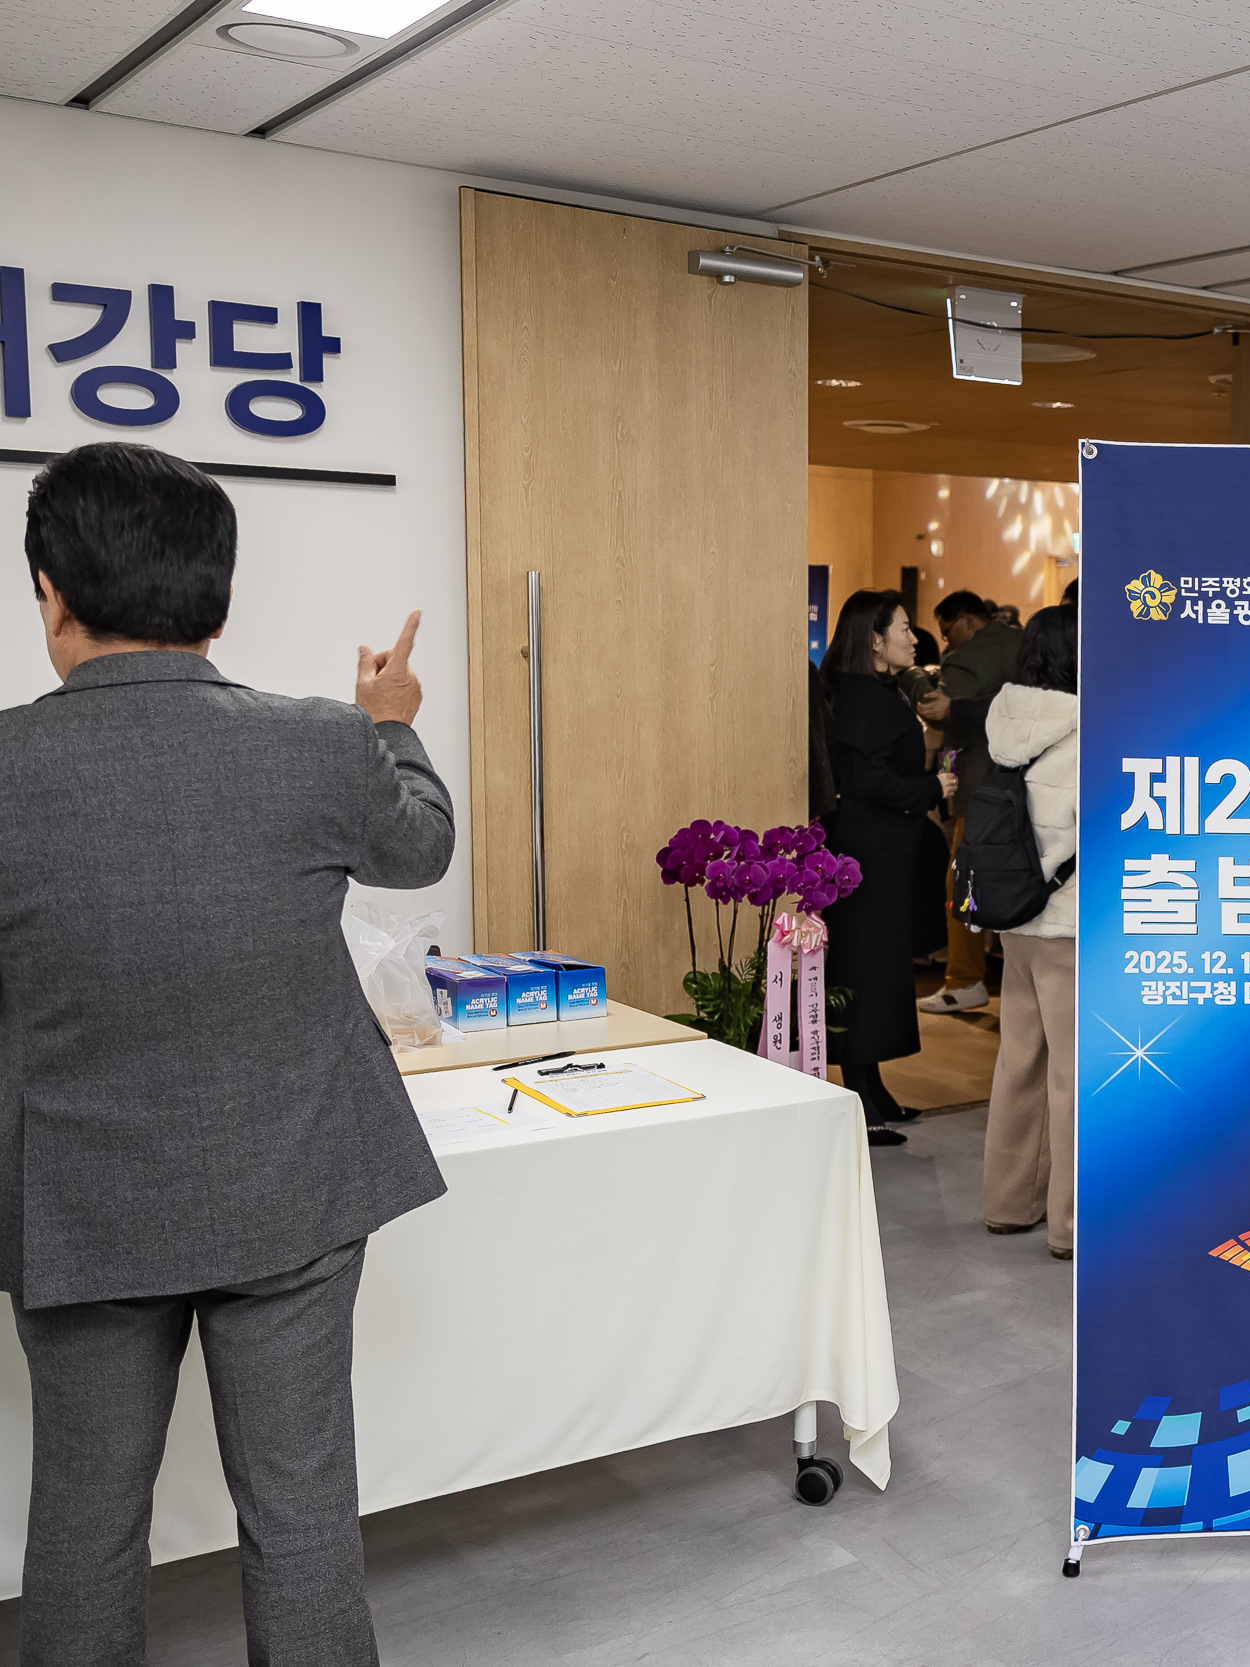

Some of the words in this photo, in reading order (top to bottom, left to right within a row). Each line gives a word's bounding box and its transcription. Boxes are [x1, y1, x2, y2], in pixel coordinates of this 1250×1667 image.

[1124, 950, 1194, 974] 2025.
[1201, 951, 1234, 974] 12.
[471, 997, 498, 1005] ACRYLIC
[1140, 981, 1237, 1006] 광진구청
